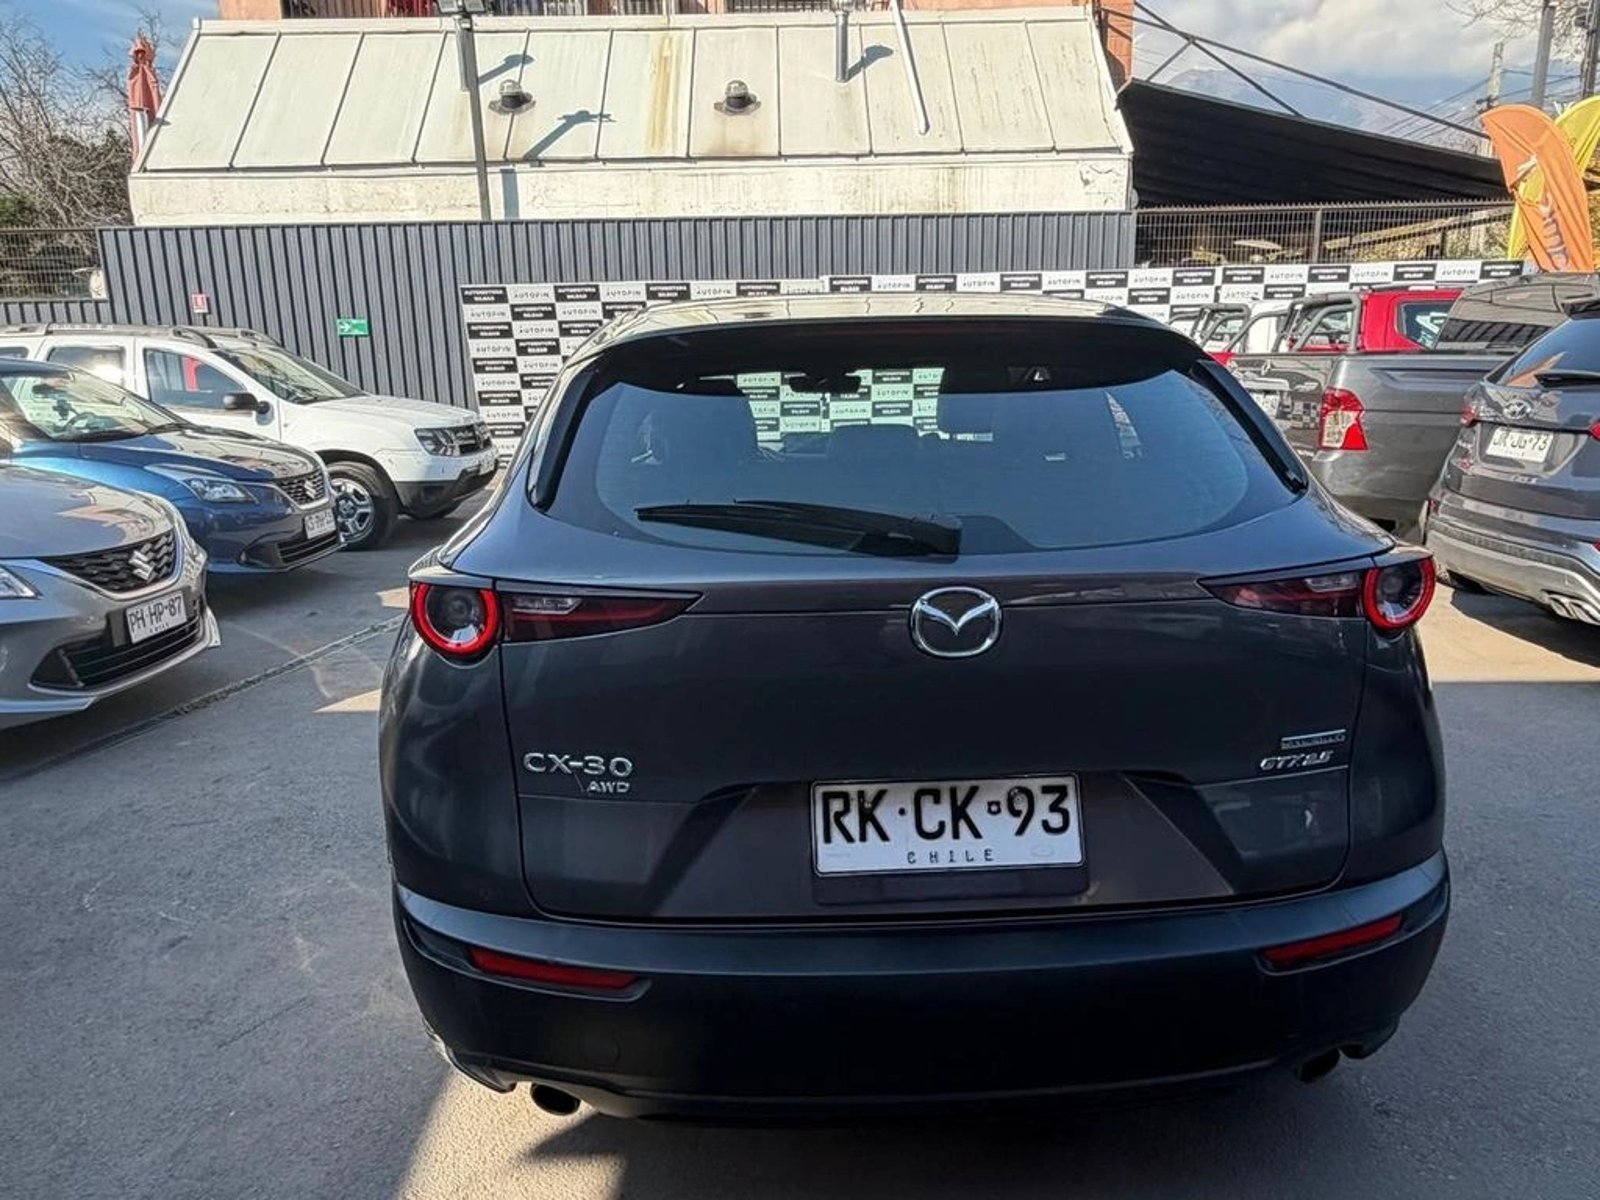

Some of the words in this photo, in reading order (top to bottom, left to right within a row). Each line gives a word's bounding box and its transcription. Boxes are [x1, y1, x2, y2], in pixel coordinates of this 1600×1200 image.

[523, 752, 632, 777] CX-30
[587, 781, 630, 793] AWD
[908, 849, 994, 864] CHILE
